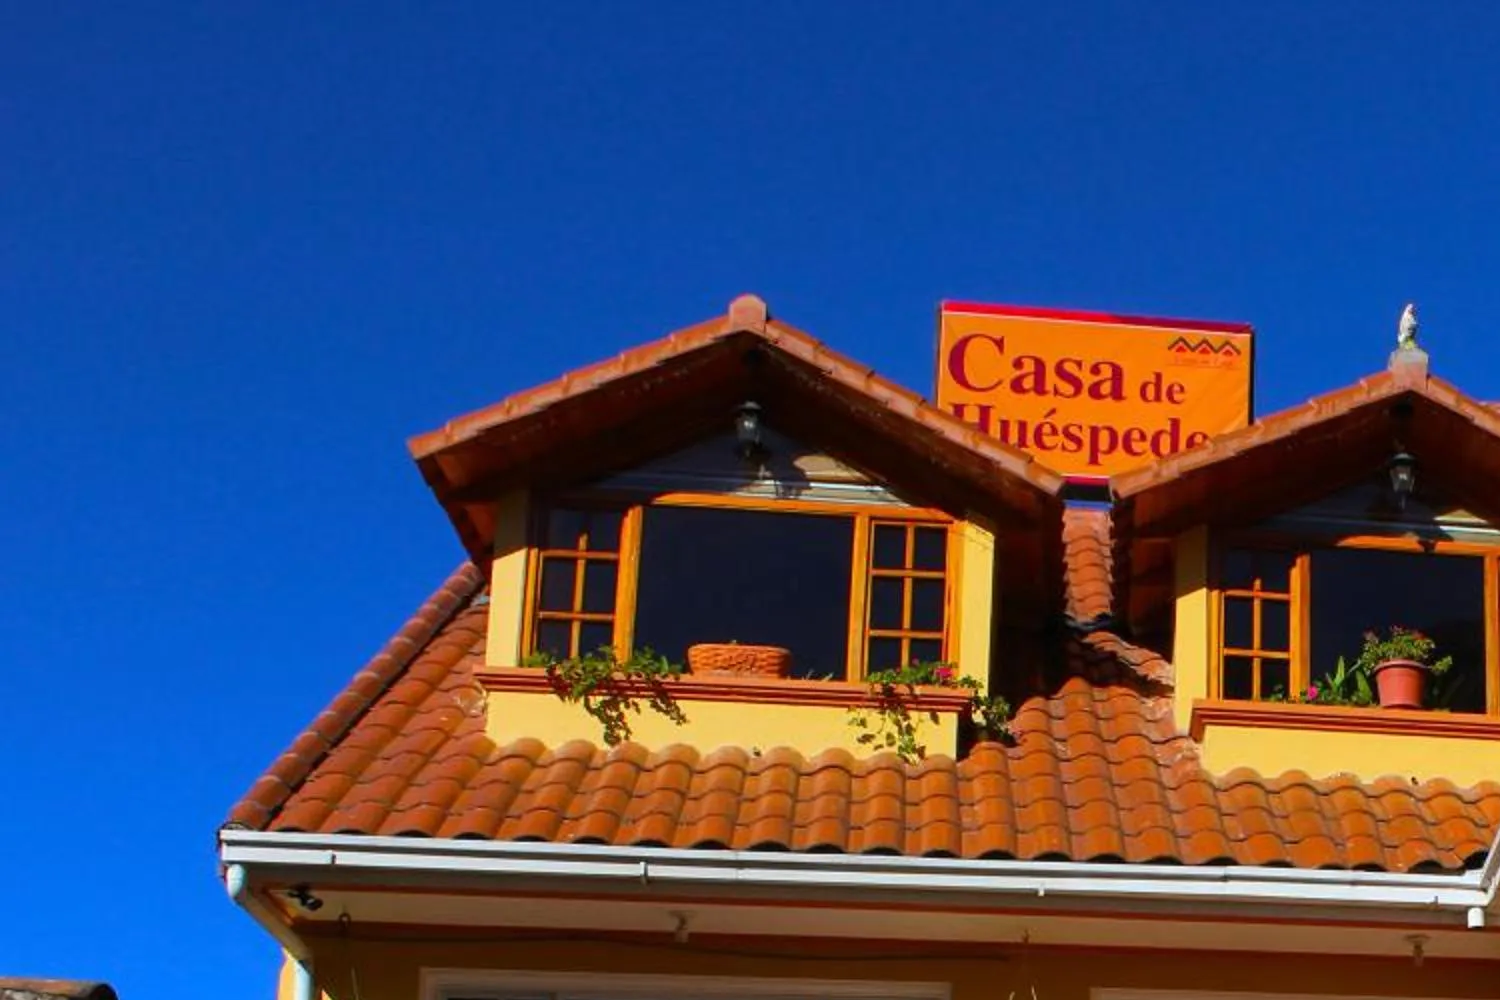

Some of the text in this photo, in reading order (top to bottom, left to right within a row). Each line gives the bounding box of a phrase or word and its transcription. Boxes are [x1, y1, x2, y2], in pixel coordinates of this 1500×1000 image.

[947, 333, 1186, 405] Casa de
[951, 402, 1210, 466] Huéspede
